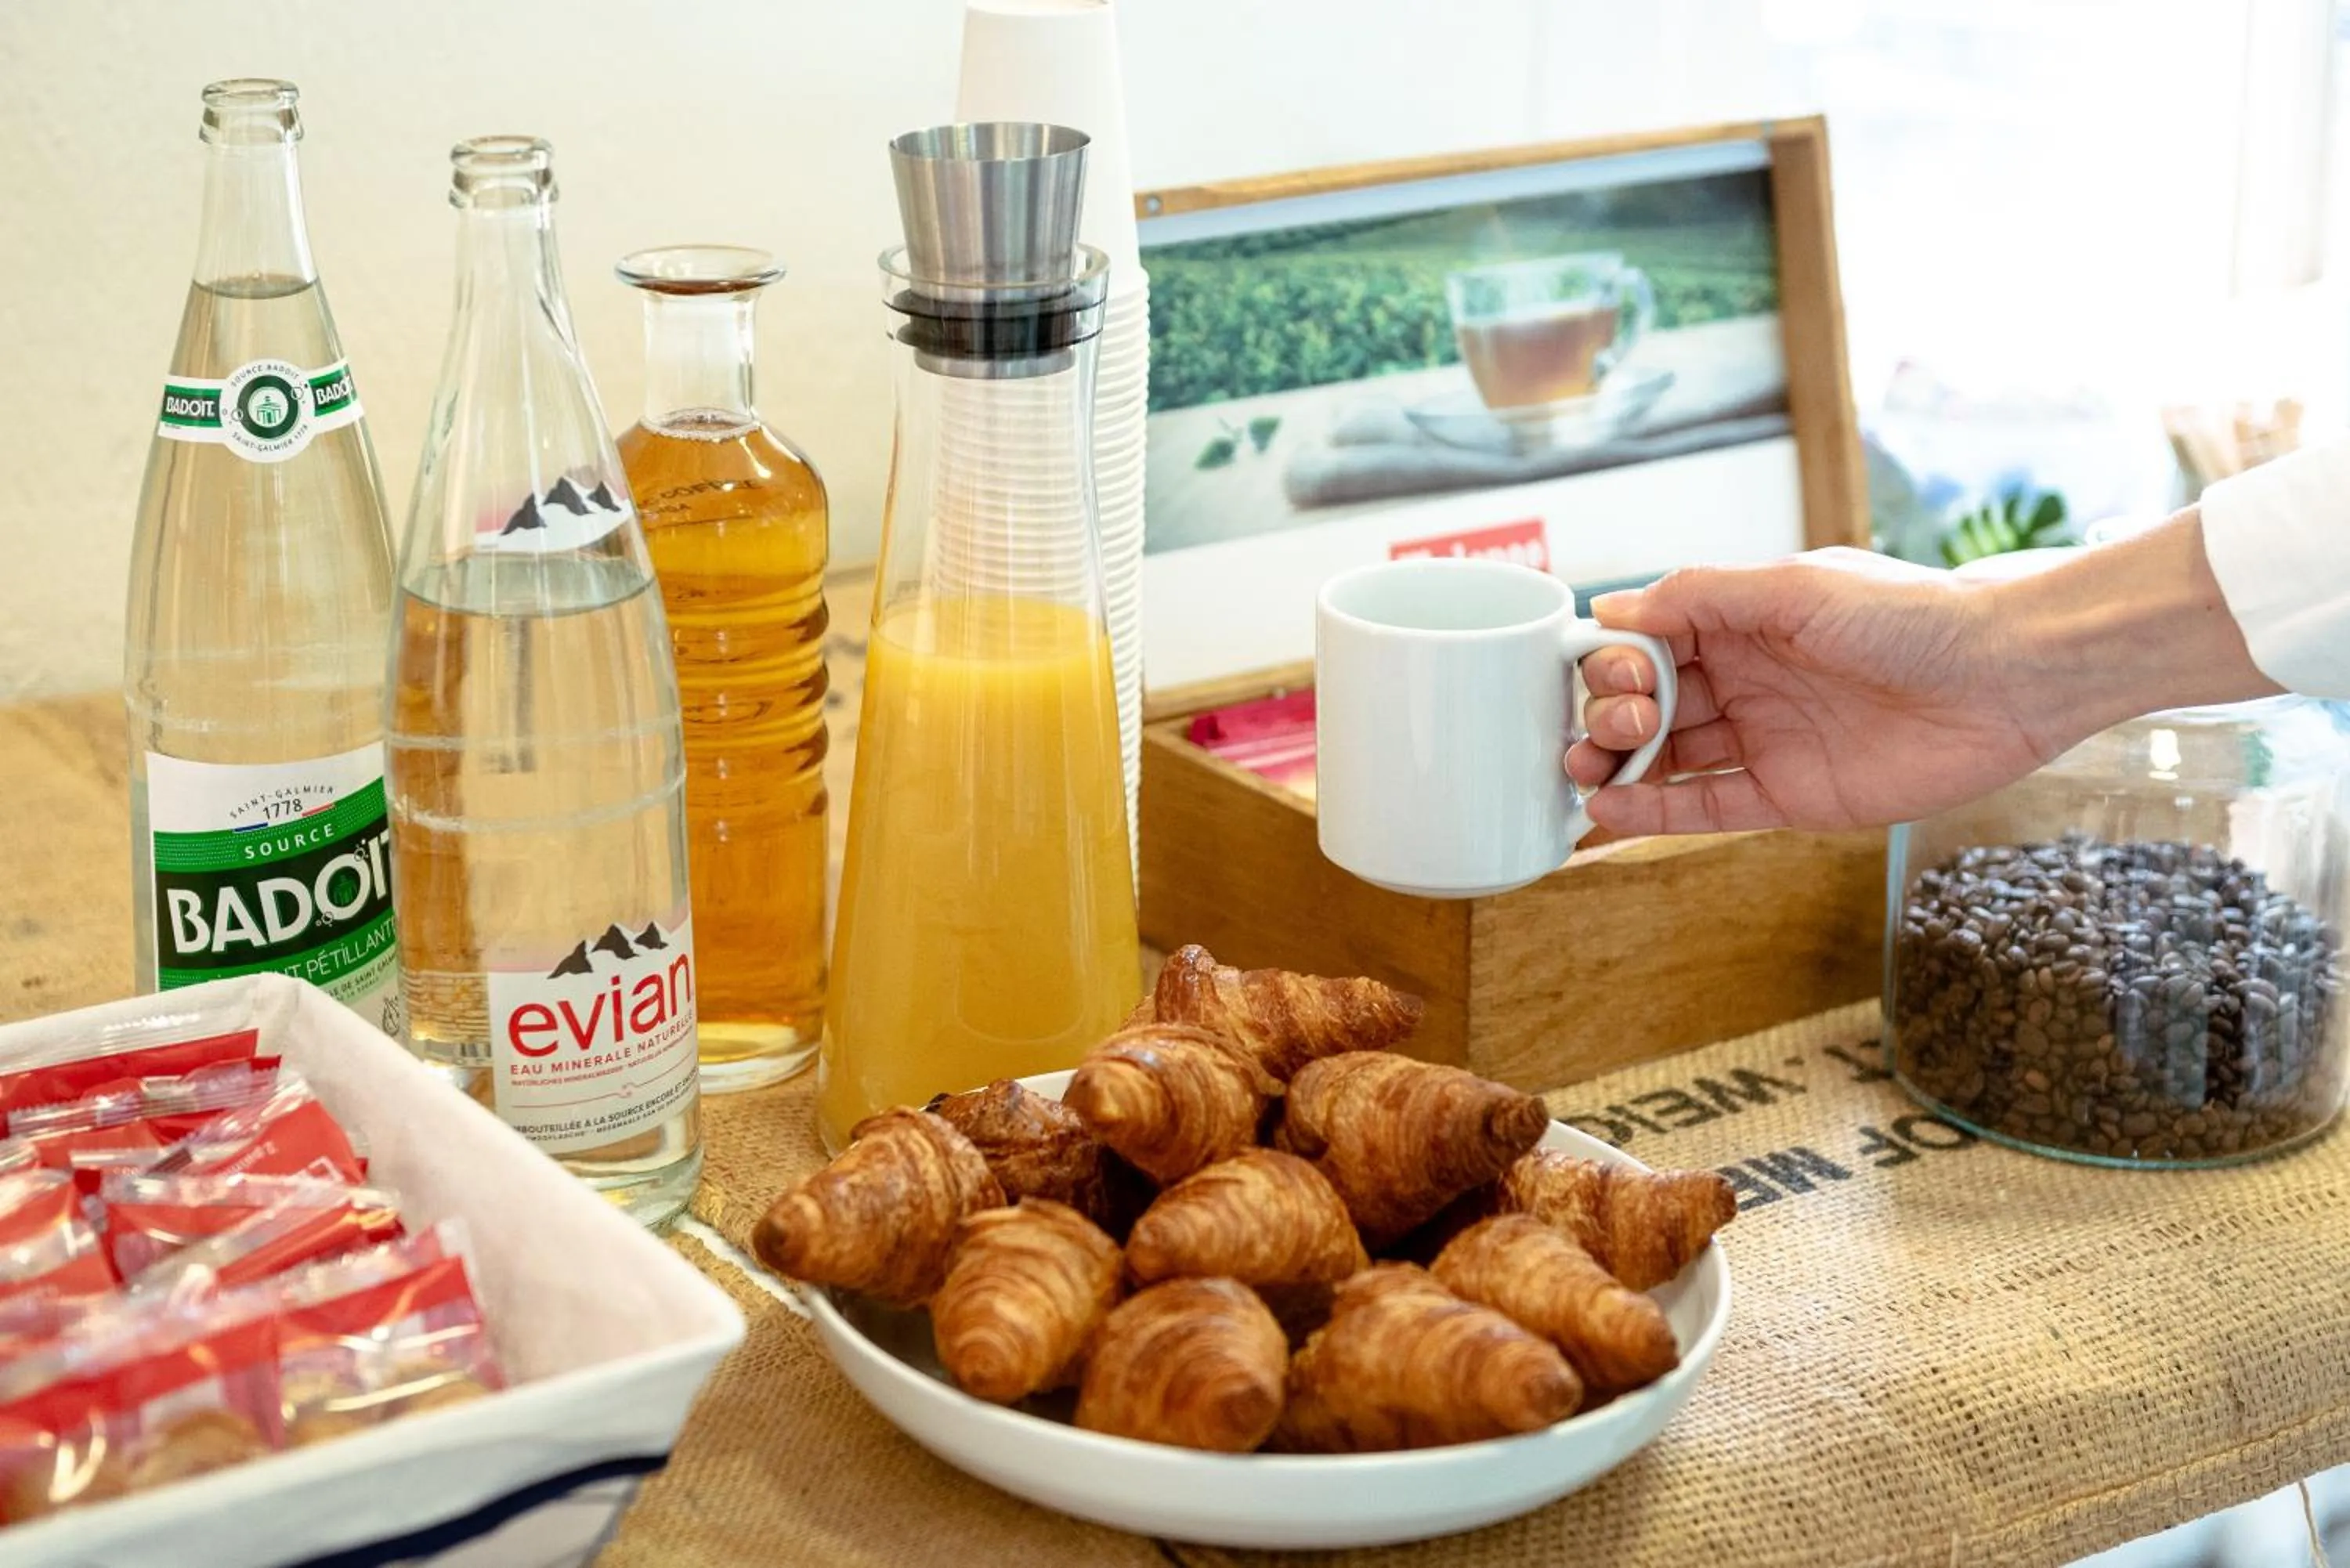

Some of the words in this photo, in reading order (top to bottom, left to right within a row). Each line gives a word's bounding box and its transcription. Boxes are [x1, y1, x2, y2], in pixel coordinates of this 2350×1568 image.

[262, 798, 303, 820] 1778
[244, 822, 334, 860] SOURCE
[508, 952, 692, 1058] evian
[510, 1064, 544, 1075] EAU
[637, 1008, 693, 1053] NATURELLE
[1858, 1111, 1979, 1169] OF
